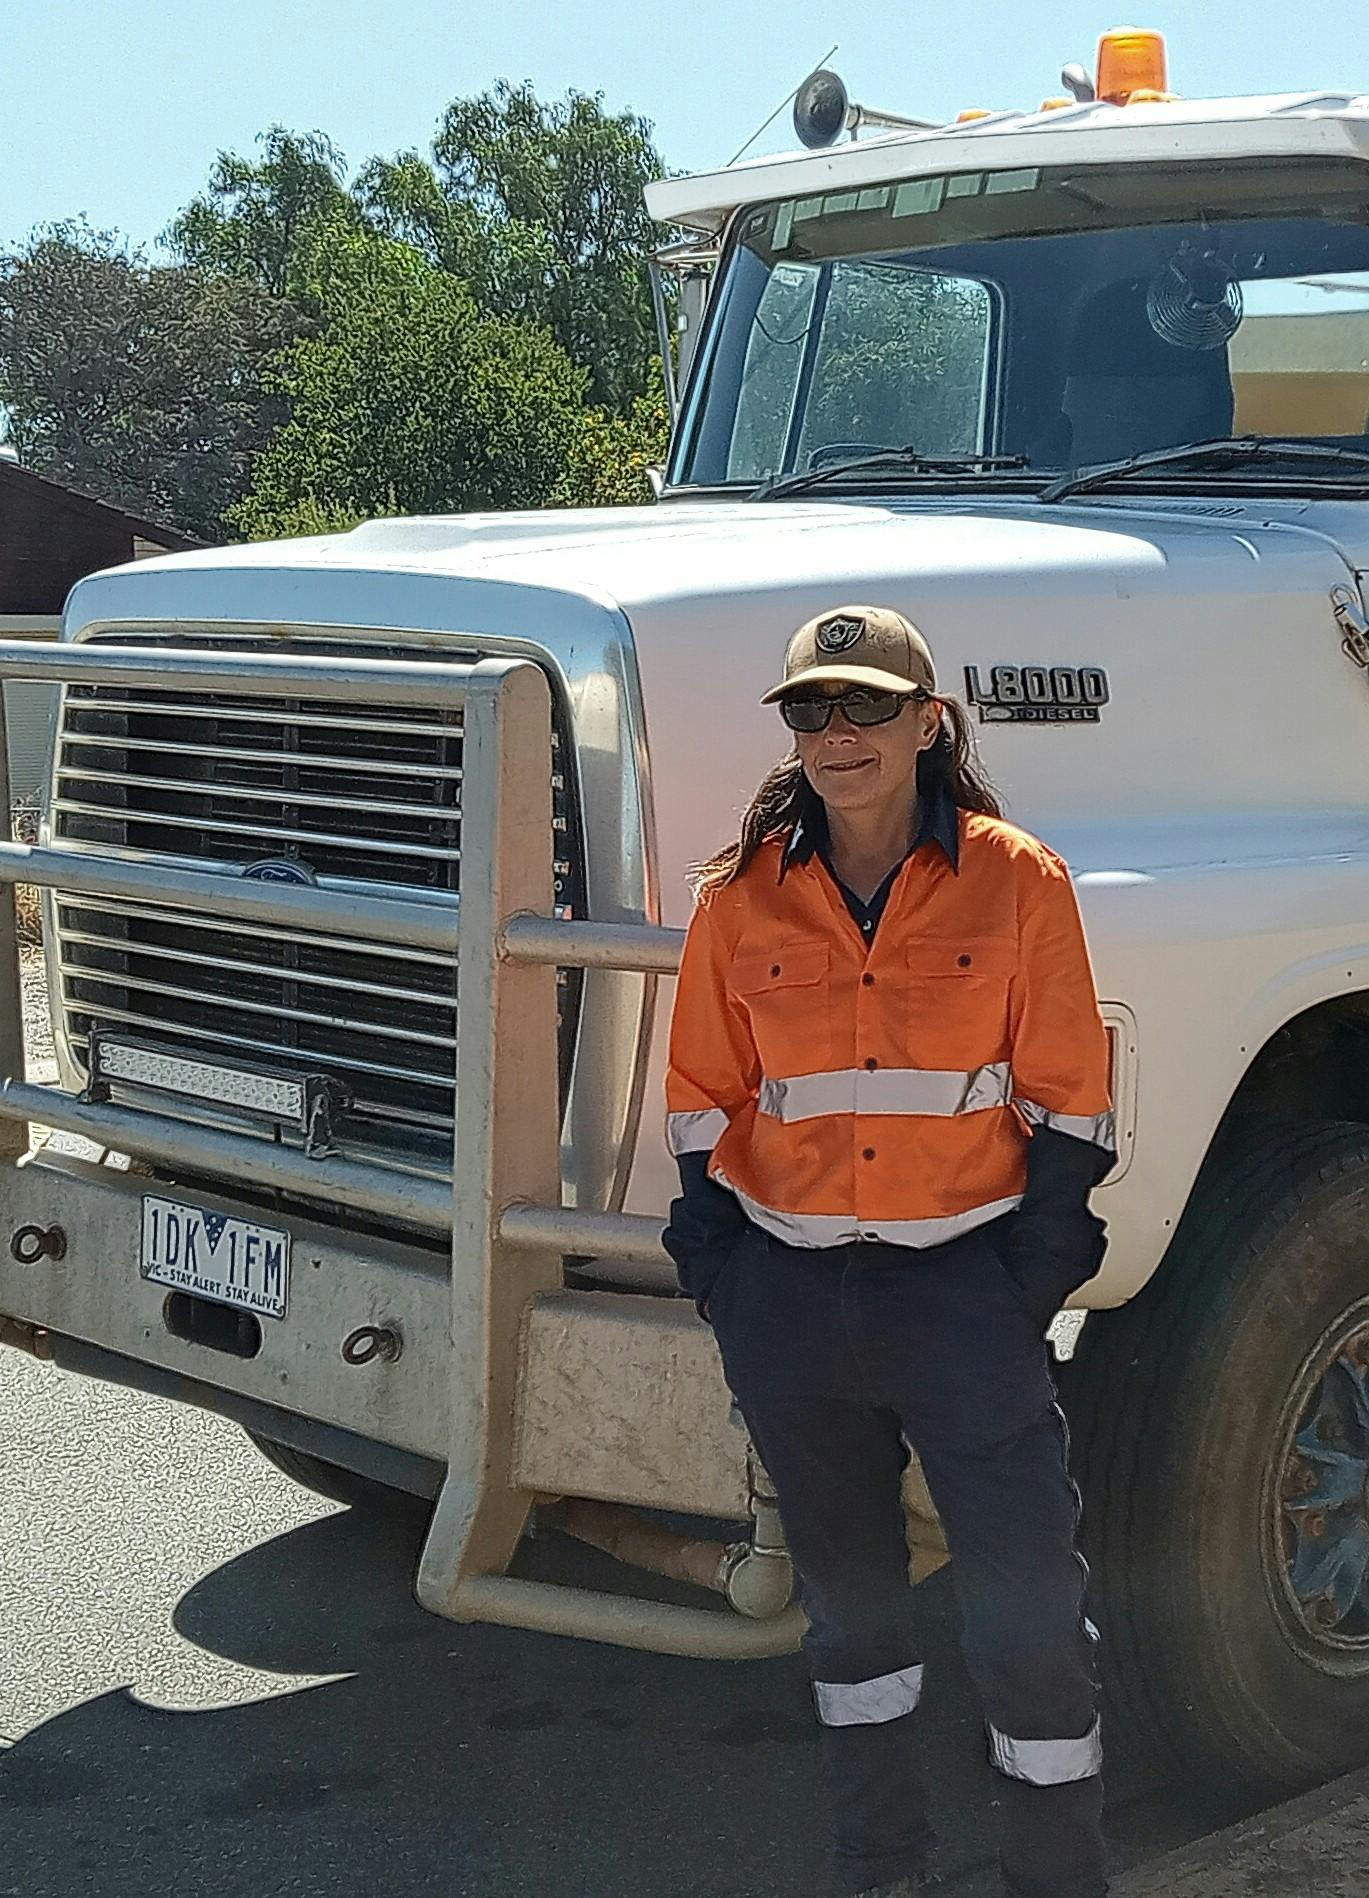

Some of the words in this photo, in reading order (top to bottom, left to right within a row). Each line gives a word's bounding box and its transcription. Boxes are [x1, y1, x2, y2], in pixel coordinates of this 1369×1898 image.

[963, 665, 1110, 706] L8000
[1026, 708, 1096, 720] DIESEL
[151, 1208, 200, 1273] 1DK
[228, 1230, 282, 1297] 1FM
[170, 1268, 192, 1285] STAY
[193, 1276, 221, 1295] ALERT
[225, 1286, 250, 1302] STAY
[250, 1292, 279, 1311] ALIVE
